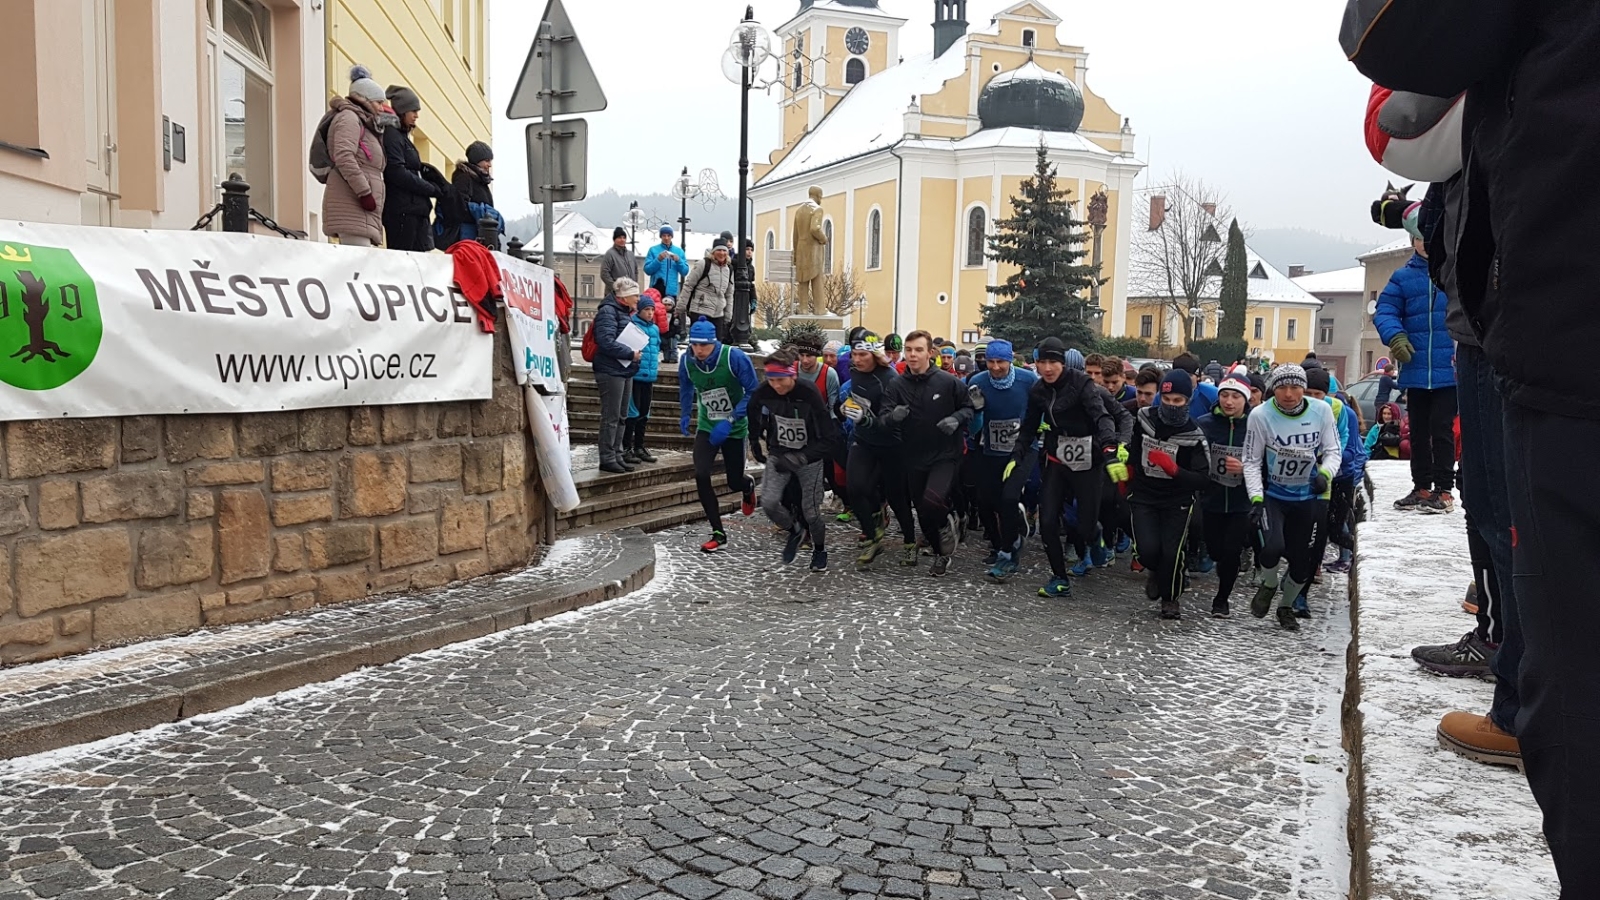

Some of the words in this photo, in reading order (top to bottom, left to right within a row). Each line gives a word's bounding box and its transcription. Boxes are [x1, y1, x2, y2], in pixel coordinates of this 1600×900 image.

[135, 260, 331, 320] MĚSTO
[351, 271, 472, 324] ÚPICE
[216, 348, 437, 390] www.upice.cz
[705, 398, 732, 413] 122
[778, 425, 806, 442] 205
[1064, 444, 1085, 463] 62
[1277, 458, 1312, 477] 197
